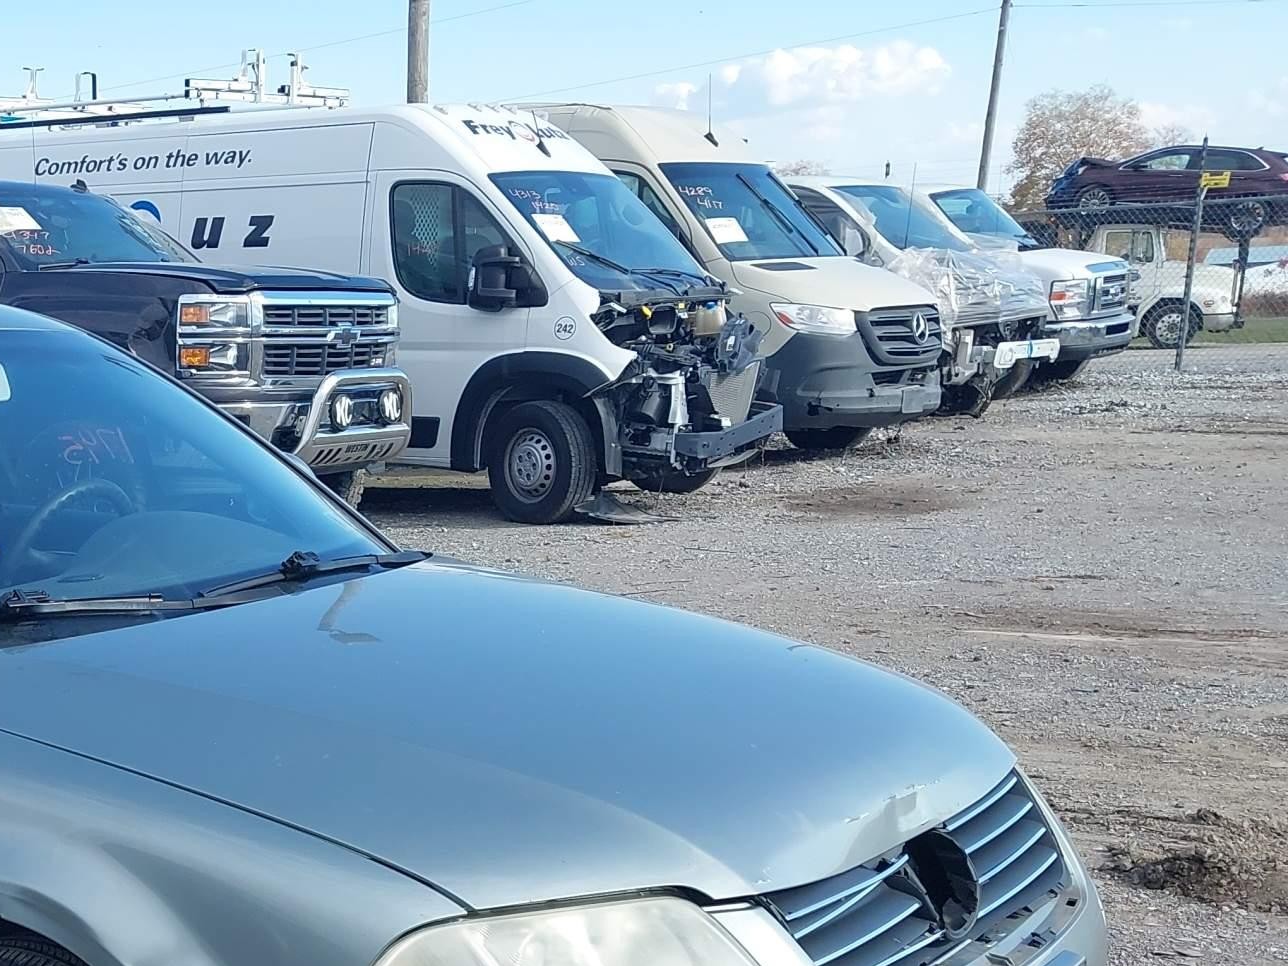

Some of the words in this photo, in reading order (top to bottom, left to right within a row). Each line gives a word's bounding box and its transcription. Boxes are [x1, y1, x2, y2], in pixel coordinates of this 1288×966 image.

[460, 119, 517, 140] Frey
[34, 152, 129, 177] Comfort's
[133, 155, 159, 170] on
[165, 149, 199, 169] the
[205, 149, 252, 169] way.
[556, 323, 575, 334] 242
[335, 396, 353, 427] KC
[383, 391, 402, 421] KC
